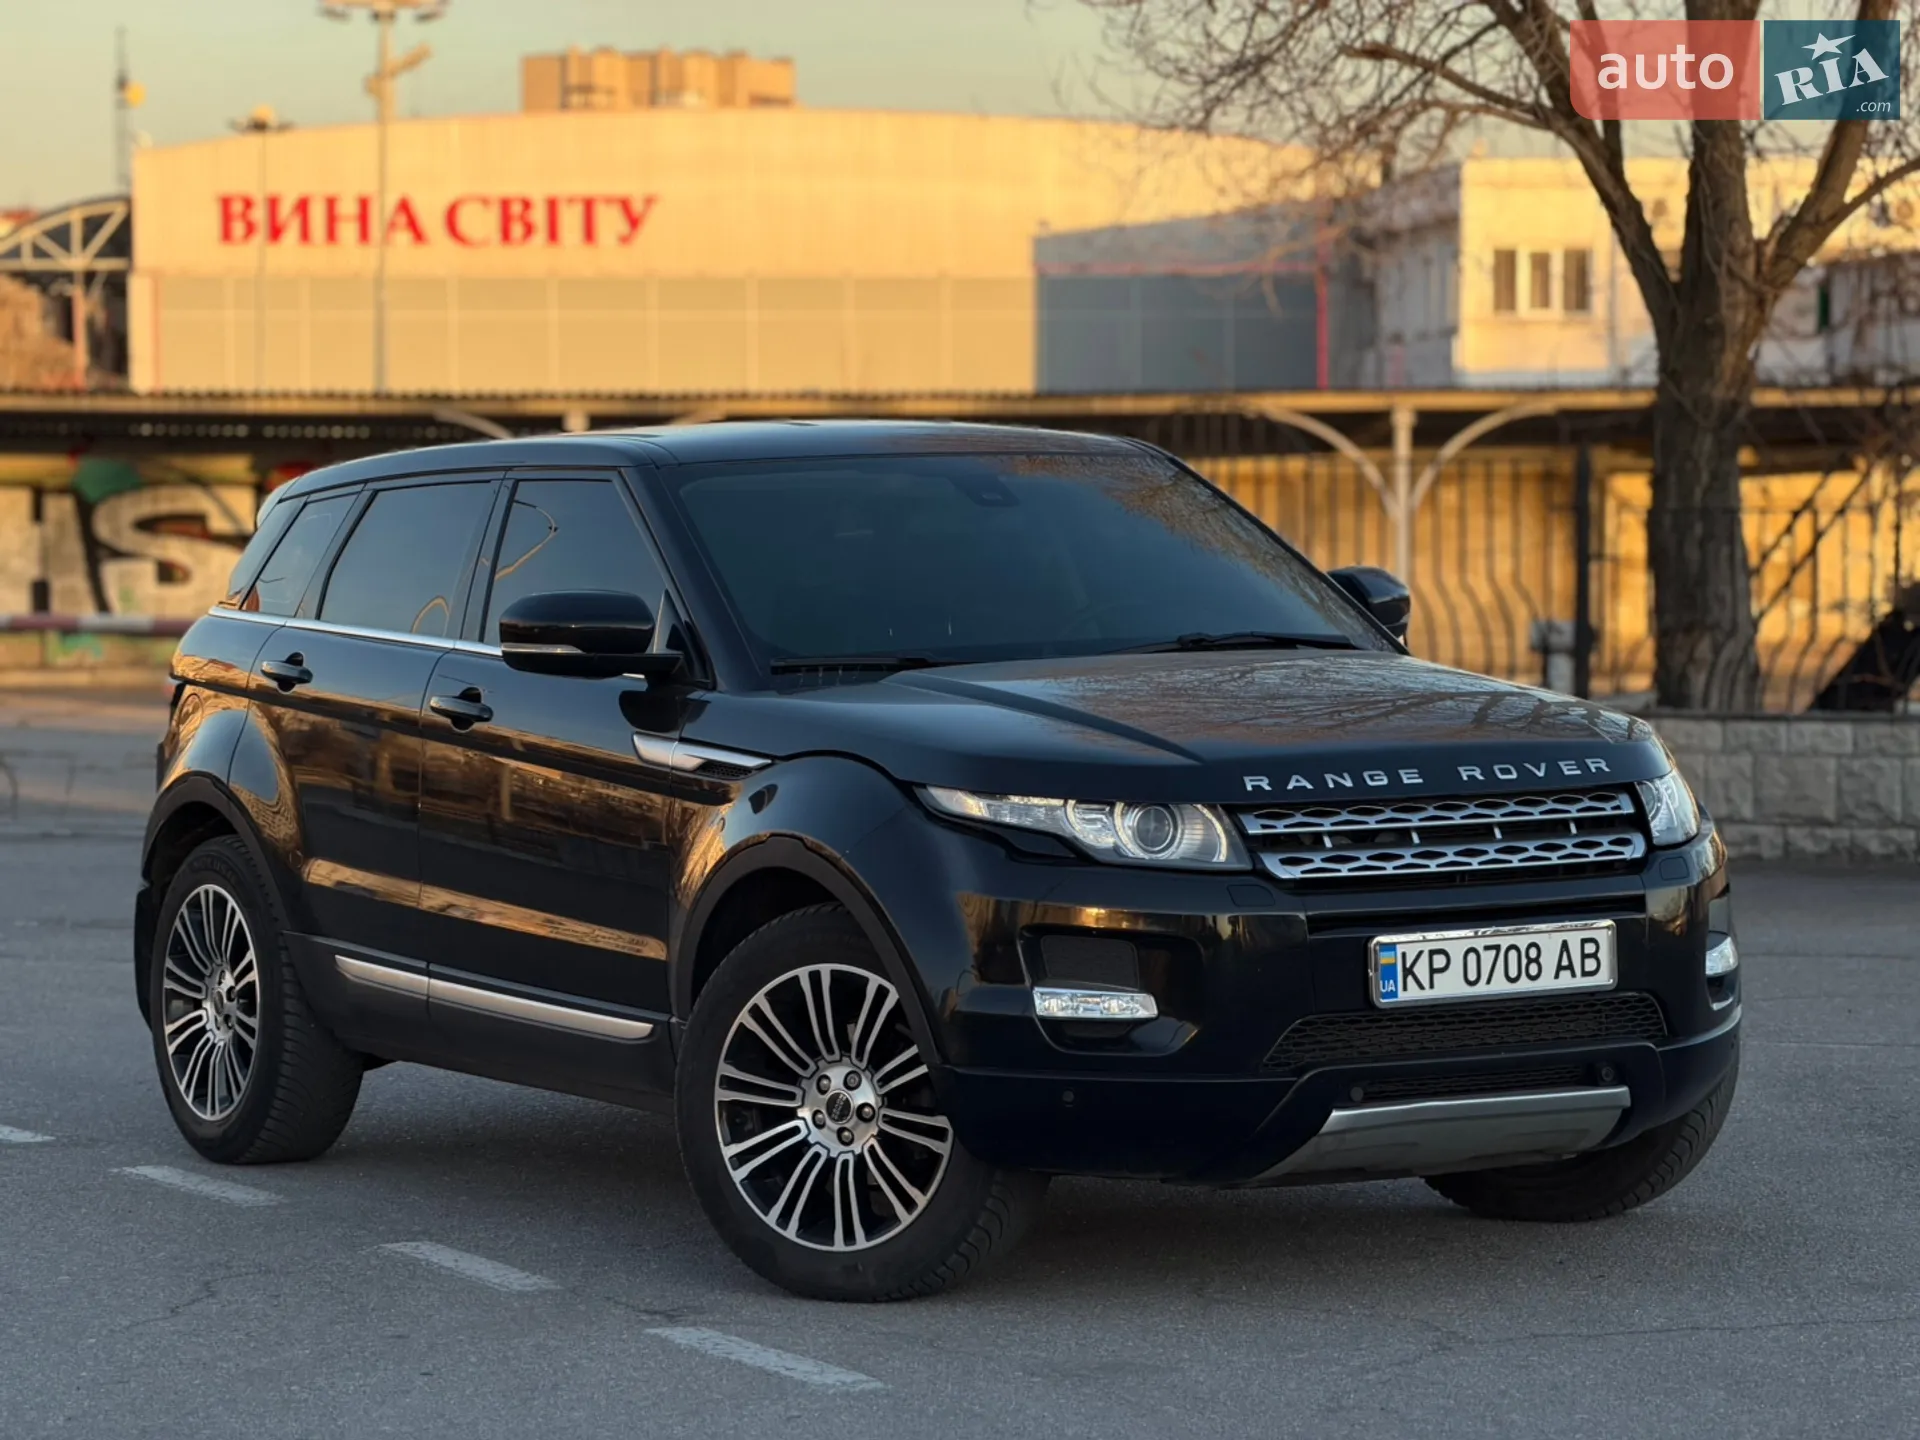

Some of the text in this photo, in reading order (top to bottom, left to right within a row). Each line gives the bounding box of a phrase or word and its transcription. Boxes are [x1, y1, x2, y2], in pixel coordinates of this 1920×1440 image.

[216, 191, 661, 249] ВИНА СВІТУ
[1242, 757, 1611, 792] RANGE ROVER
[1379, 979, 1397, 993] UA
[1401, 937, 1602, 992] KP 0708 AB
